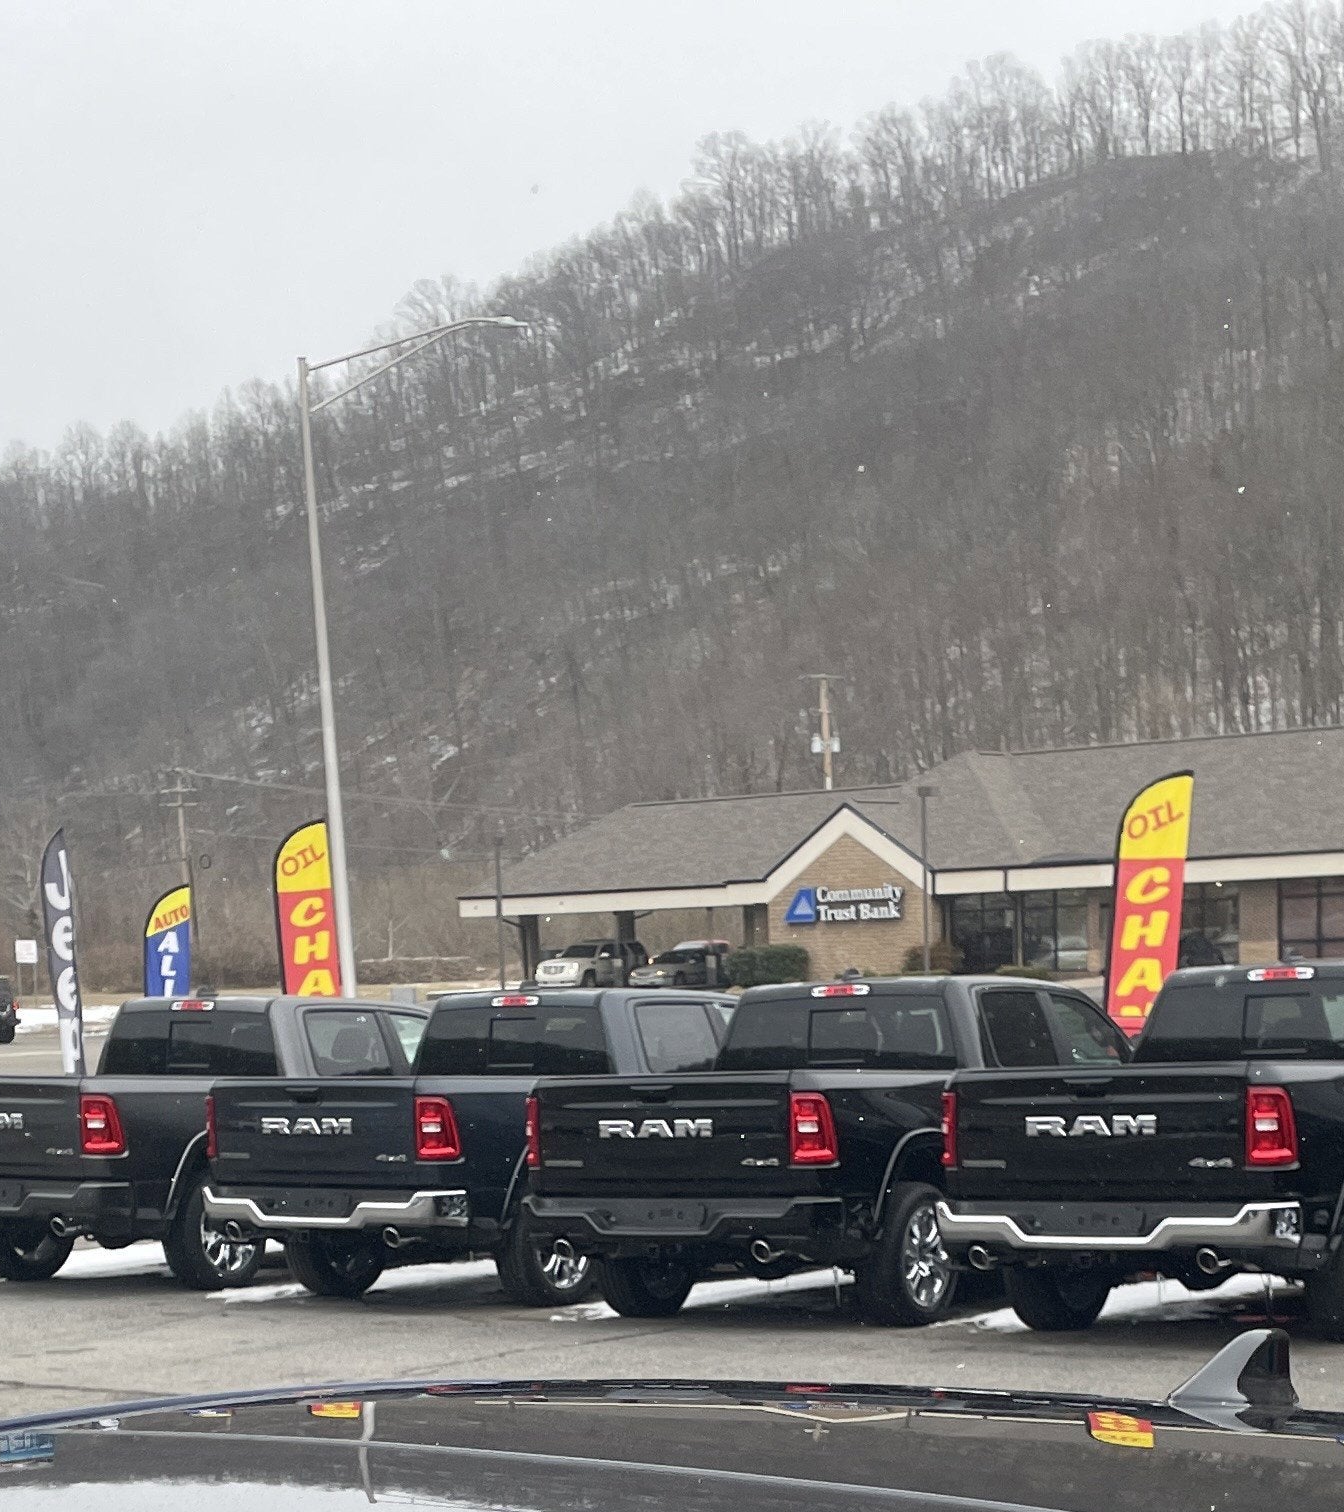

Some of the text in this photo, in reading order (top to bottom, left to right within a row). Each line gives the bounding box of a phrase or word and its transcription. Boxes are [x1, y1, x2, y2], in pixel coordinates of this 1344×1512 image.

[1127, 801, 1185, 840] OIL
[281, 844, 325, 877] OIL
[817, 883, 903, 902] Community
[154, 905, 189, 931] AUTO
[817, 901, 901, 921] Trust Bank
[260, 1117, 354, 1136] RAM
[598, 1119, 713, 1138] RAM
[1025, 1115, 1157, 1137] RAM
